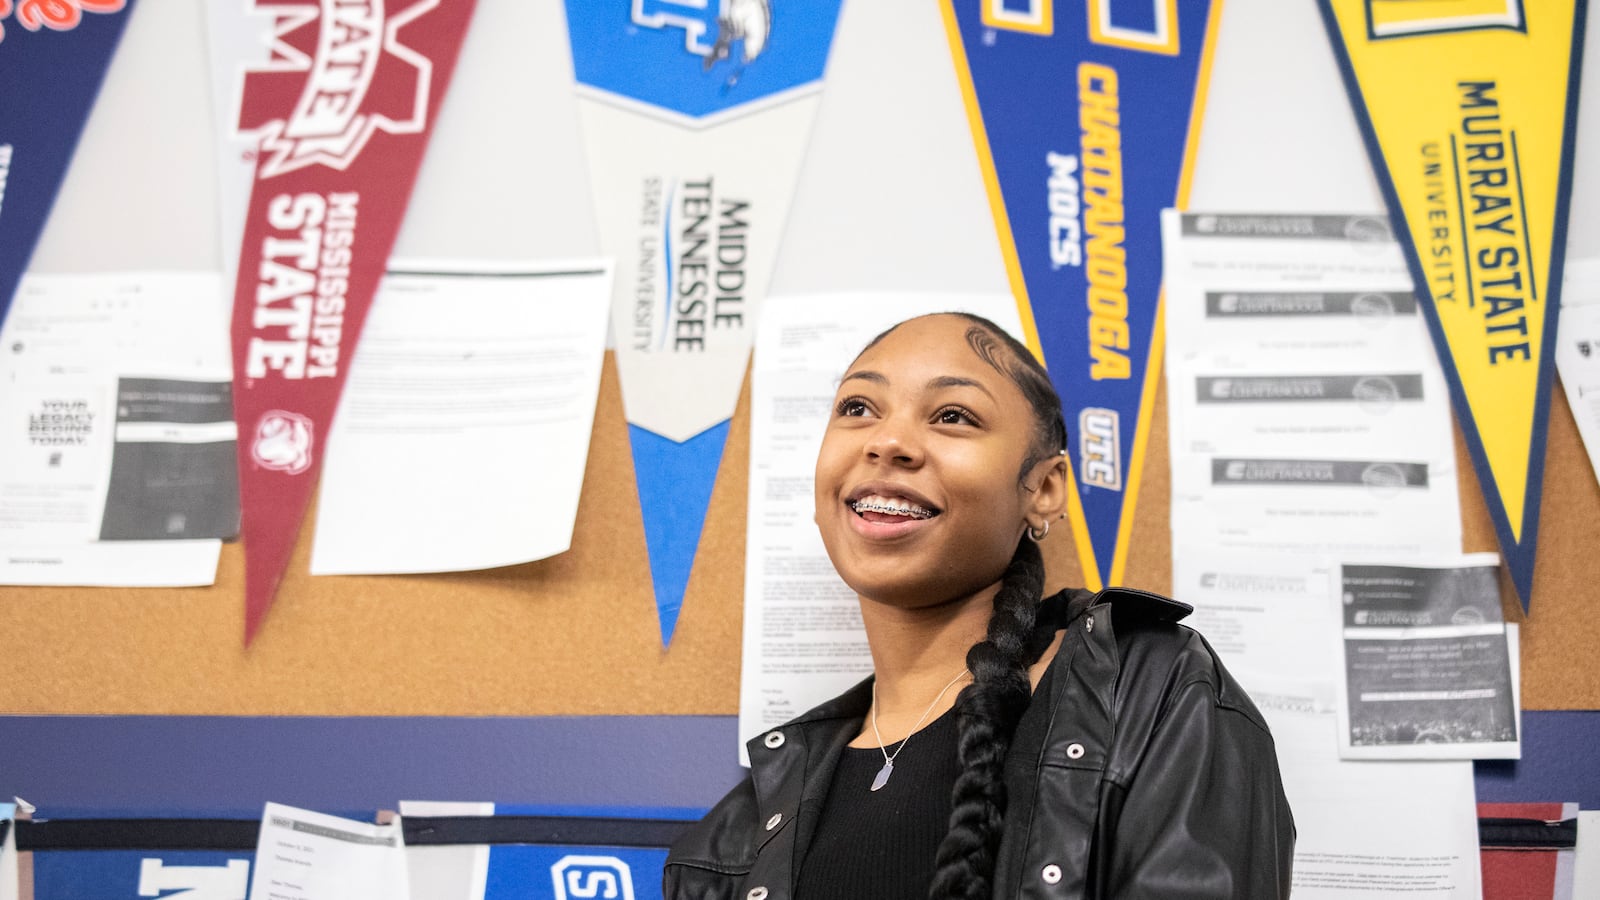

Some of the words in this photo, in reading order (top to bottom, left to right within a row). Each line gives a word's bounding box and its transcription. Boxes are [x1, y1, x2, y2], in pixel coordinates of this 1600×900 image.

[640, 177, 661, 227] STATE
[1046, 151, 1081, 267] MOCS
[1077, 62, 1131, 381] CHATTANOOGA
[1420, 142, 1455, 303] UNIVERSITY
[1457, 81, 1516, 237] MURRAY
[246, 192, 326, 380] STATE
[308, 192, 359, 379] MISSISSIPPI
[633, 236, 656, 353] UNIVERSITY
[675, 174, 714, 352] TENNESSEE
[714, 199, 752, 330] MIDDLE
[1477, 246, 1531, 366] STATE
[1085, 413, 1116, 484] UTC
